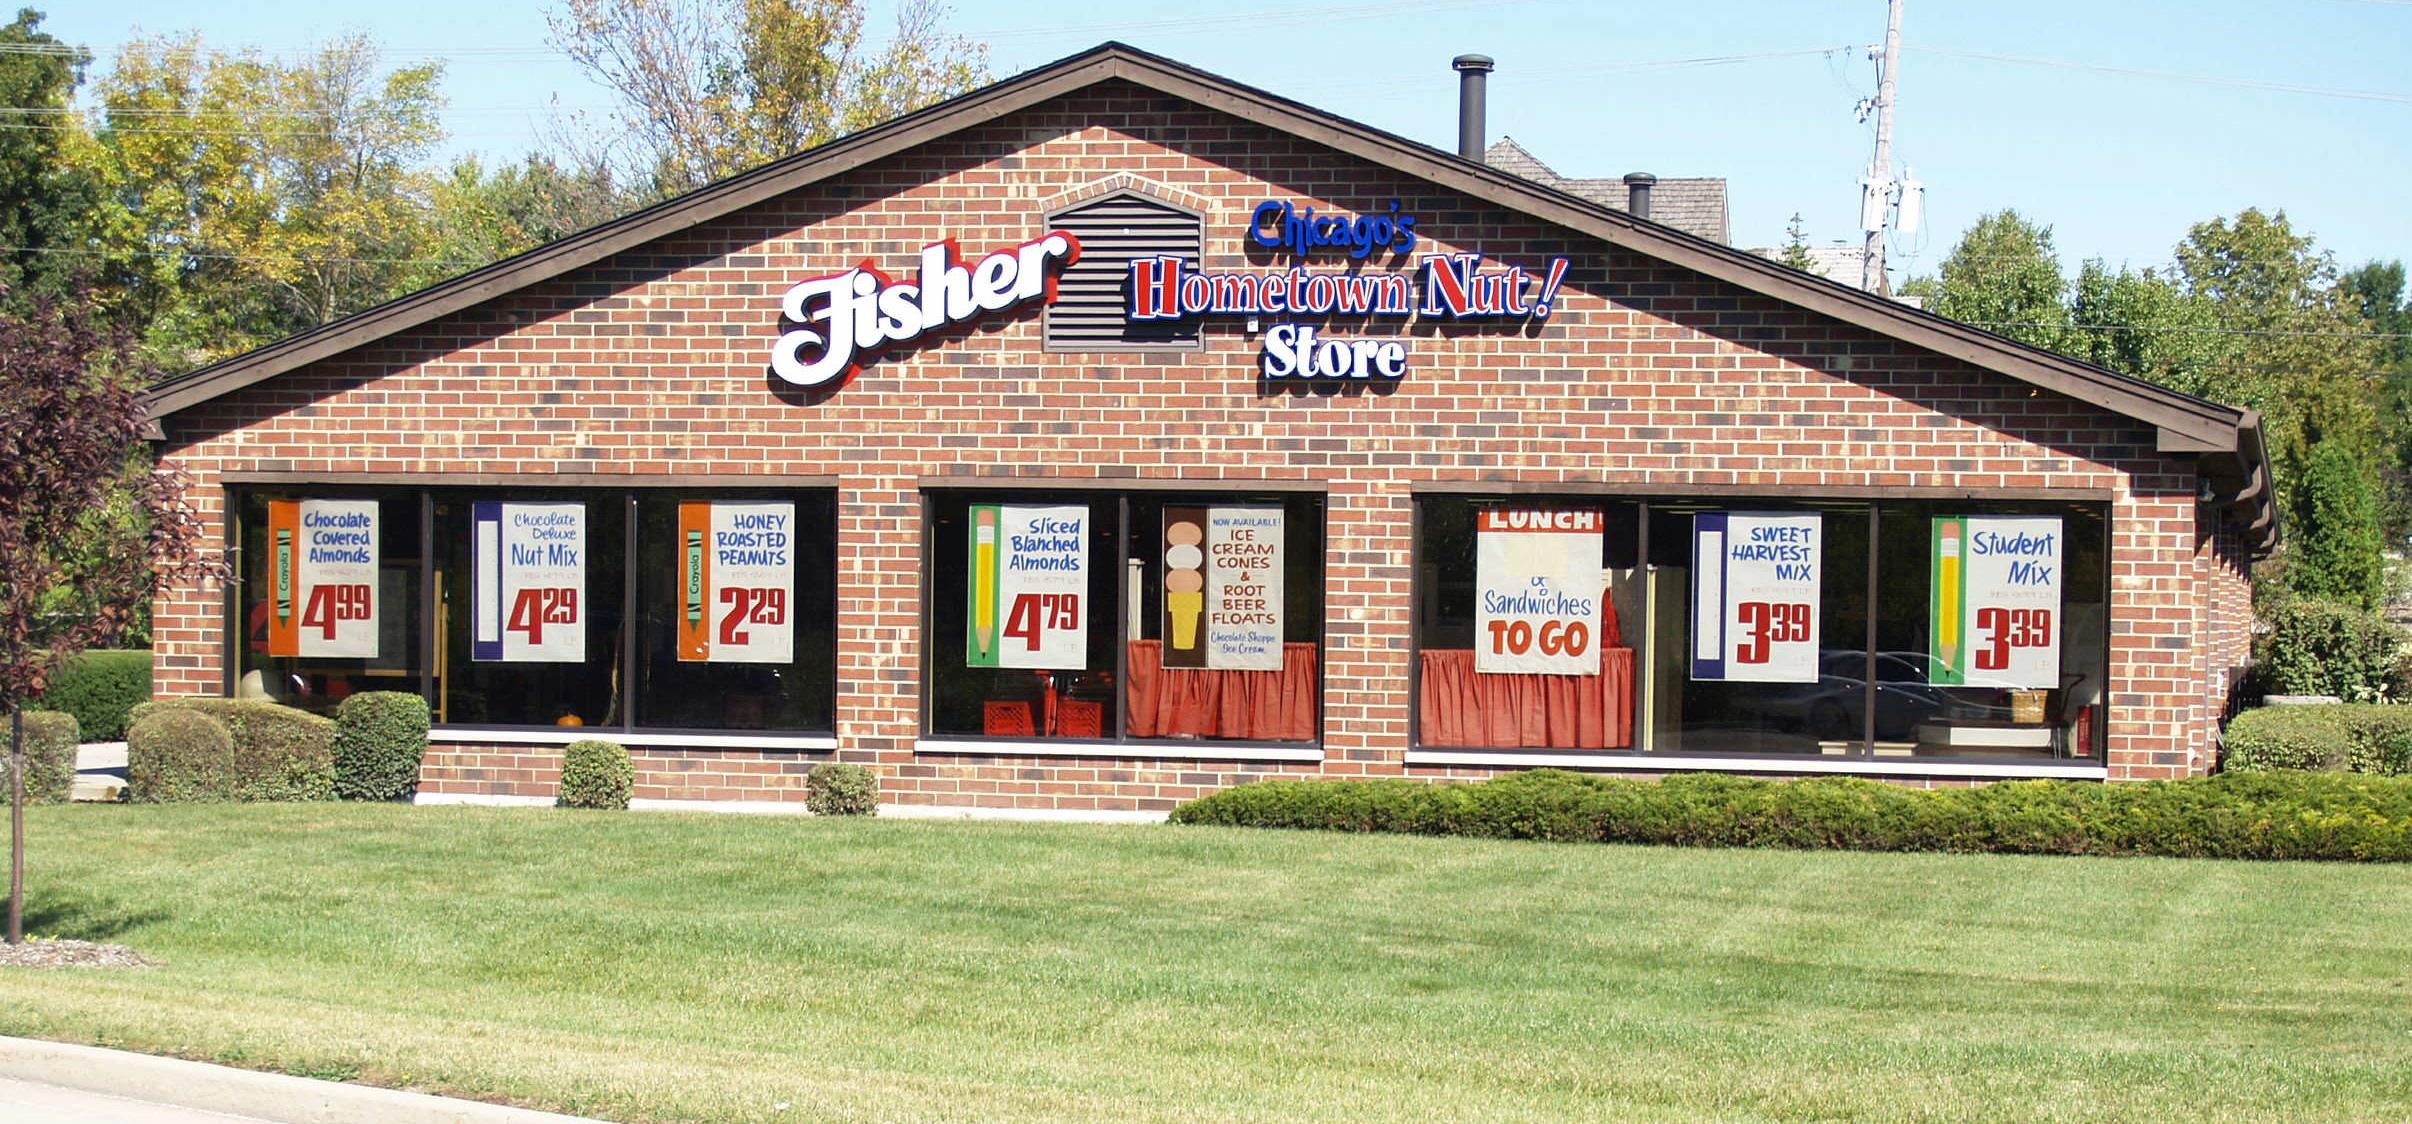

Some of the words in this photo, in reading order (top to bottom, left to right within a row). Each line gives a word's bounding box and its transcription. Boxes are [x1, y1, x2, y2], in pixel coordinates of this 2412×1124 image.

[1250, 200, 1416, 259] Chicago's
[1129, 254, 1410, 320] Hometown
[771, 231, 1080, 387] Fisher
[1264, 322, 1408, 379] Store
[304, 510, 371, 528] Chocolate
[514, 512, 576, 527] Chocolate
[734, 514, 786, 530] HONEY
[1030, 518, 1080, 534] Sliced
[1213, 518, 1230, 526] NOW
[1232, 517, 1281, 526] AVAILABLE!
[313, 530, 370, 546] Covered
[532, 528, 576, 540] Deluxe
[717, 532, 786, 548] ROASTED
[1231, 529, 1255, 541] ICE
[1751, 527, 1812, 543] SWEET
[1011, 536, 1080, 552] Blanched
[1212, 543, 1274, 555] CREAM
[1973, 531, 2054, 556] Student
[309, 548, 371, 563] Almonds
[512, 543, 544, 566] Nut
[549, 543, 577, 567] Mix
[719, 550, 786, 566] PEANUTS
[1731, 545, 1812, 562] HARVEST
[1009, 554, 1080, 571] Almonds
[1217, 557, 1270, 569] CONES
[689, 554, 699, 595] Crayola
[1240, 571, 1250, 581] &
[1776, 564, 1812, 581] MIX
[2008, 560, 2052, 585] Mix
[1224, 585, 1266, 596] ROOT
[1223, 599, 1266, 611] BEER
[1485, 588, 1591, 616] Sandwiches
[1212, 613, 1276, 625] FLOATS
[1488, 620, 1532, 656] TO
[1539, 620, 1589, 657] GO
